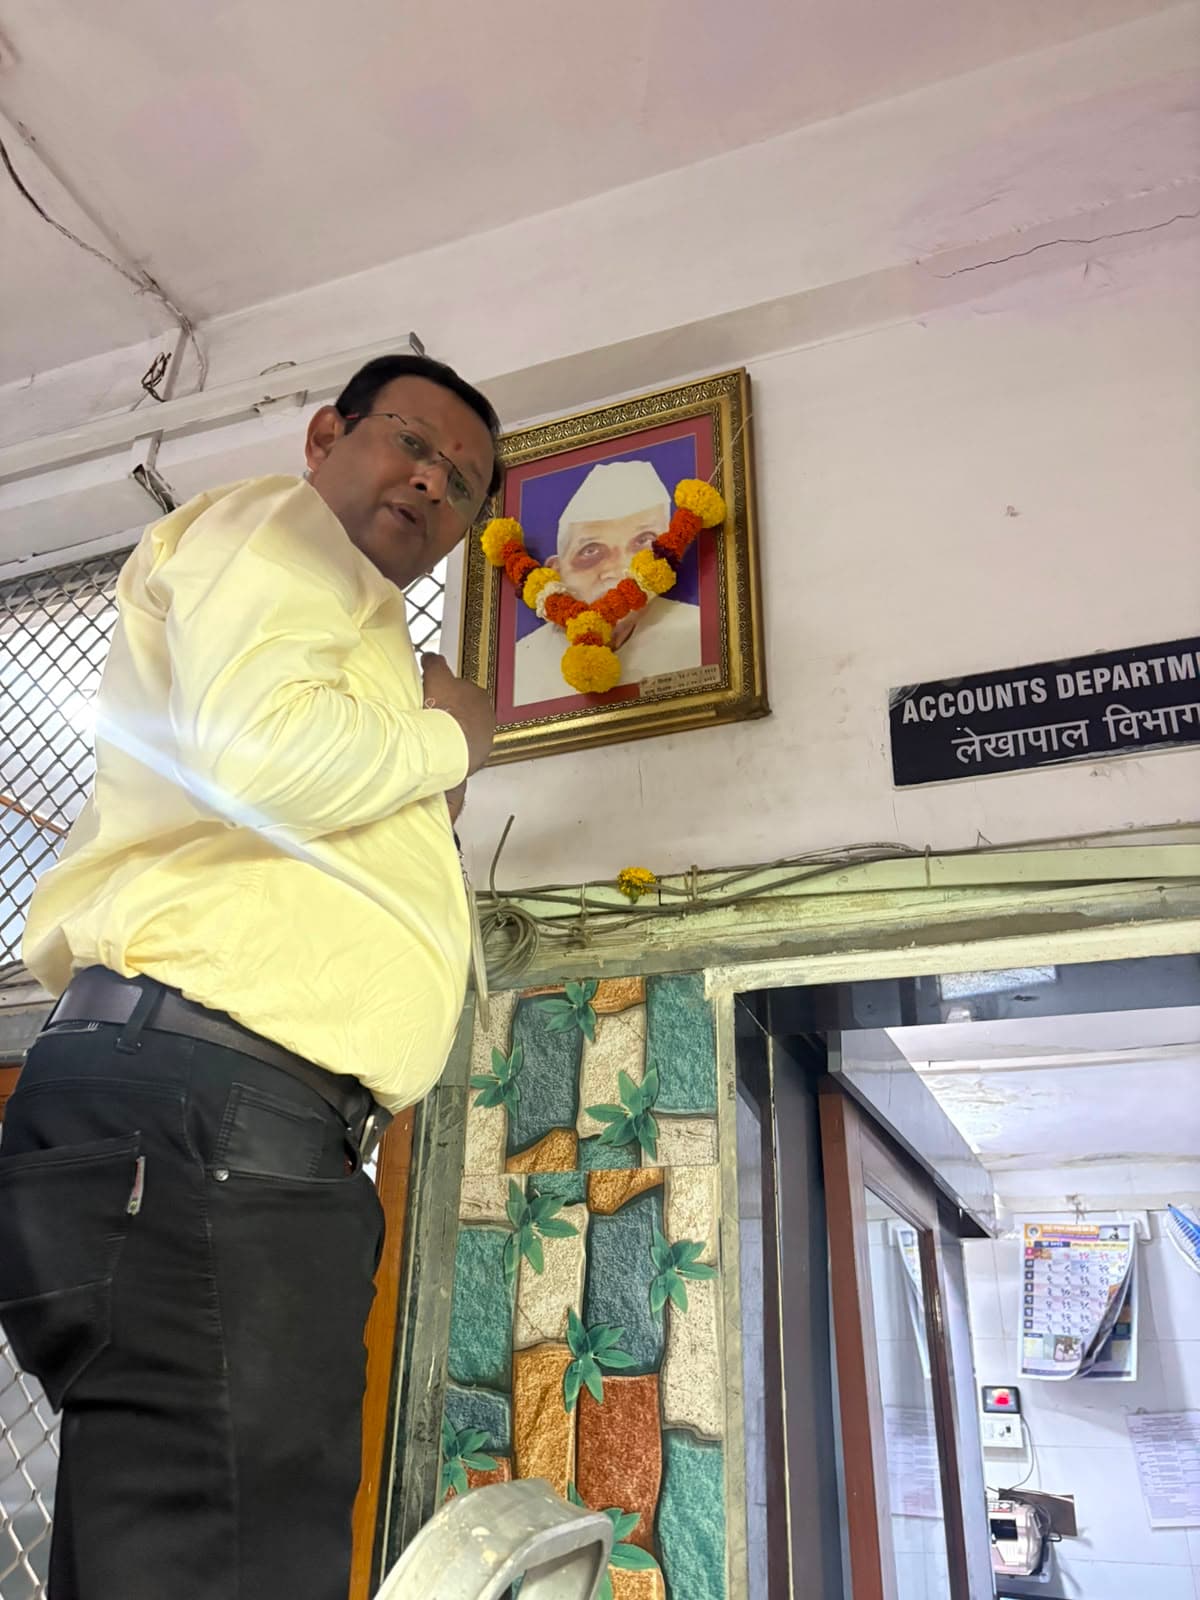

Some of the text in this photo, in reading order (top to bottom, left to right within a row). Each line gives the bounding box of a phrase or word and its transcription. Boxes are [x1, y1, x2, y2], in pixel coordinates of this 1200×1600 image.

[902, 651, 1200, 724] ACCOUNTS DEPARTM
[951, 719, 1090, 764] लेखापाल
